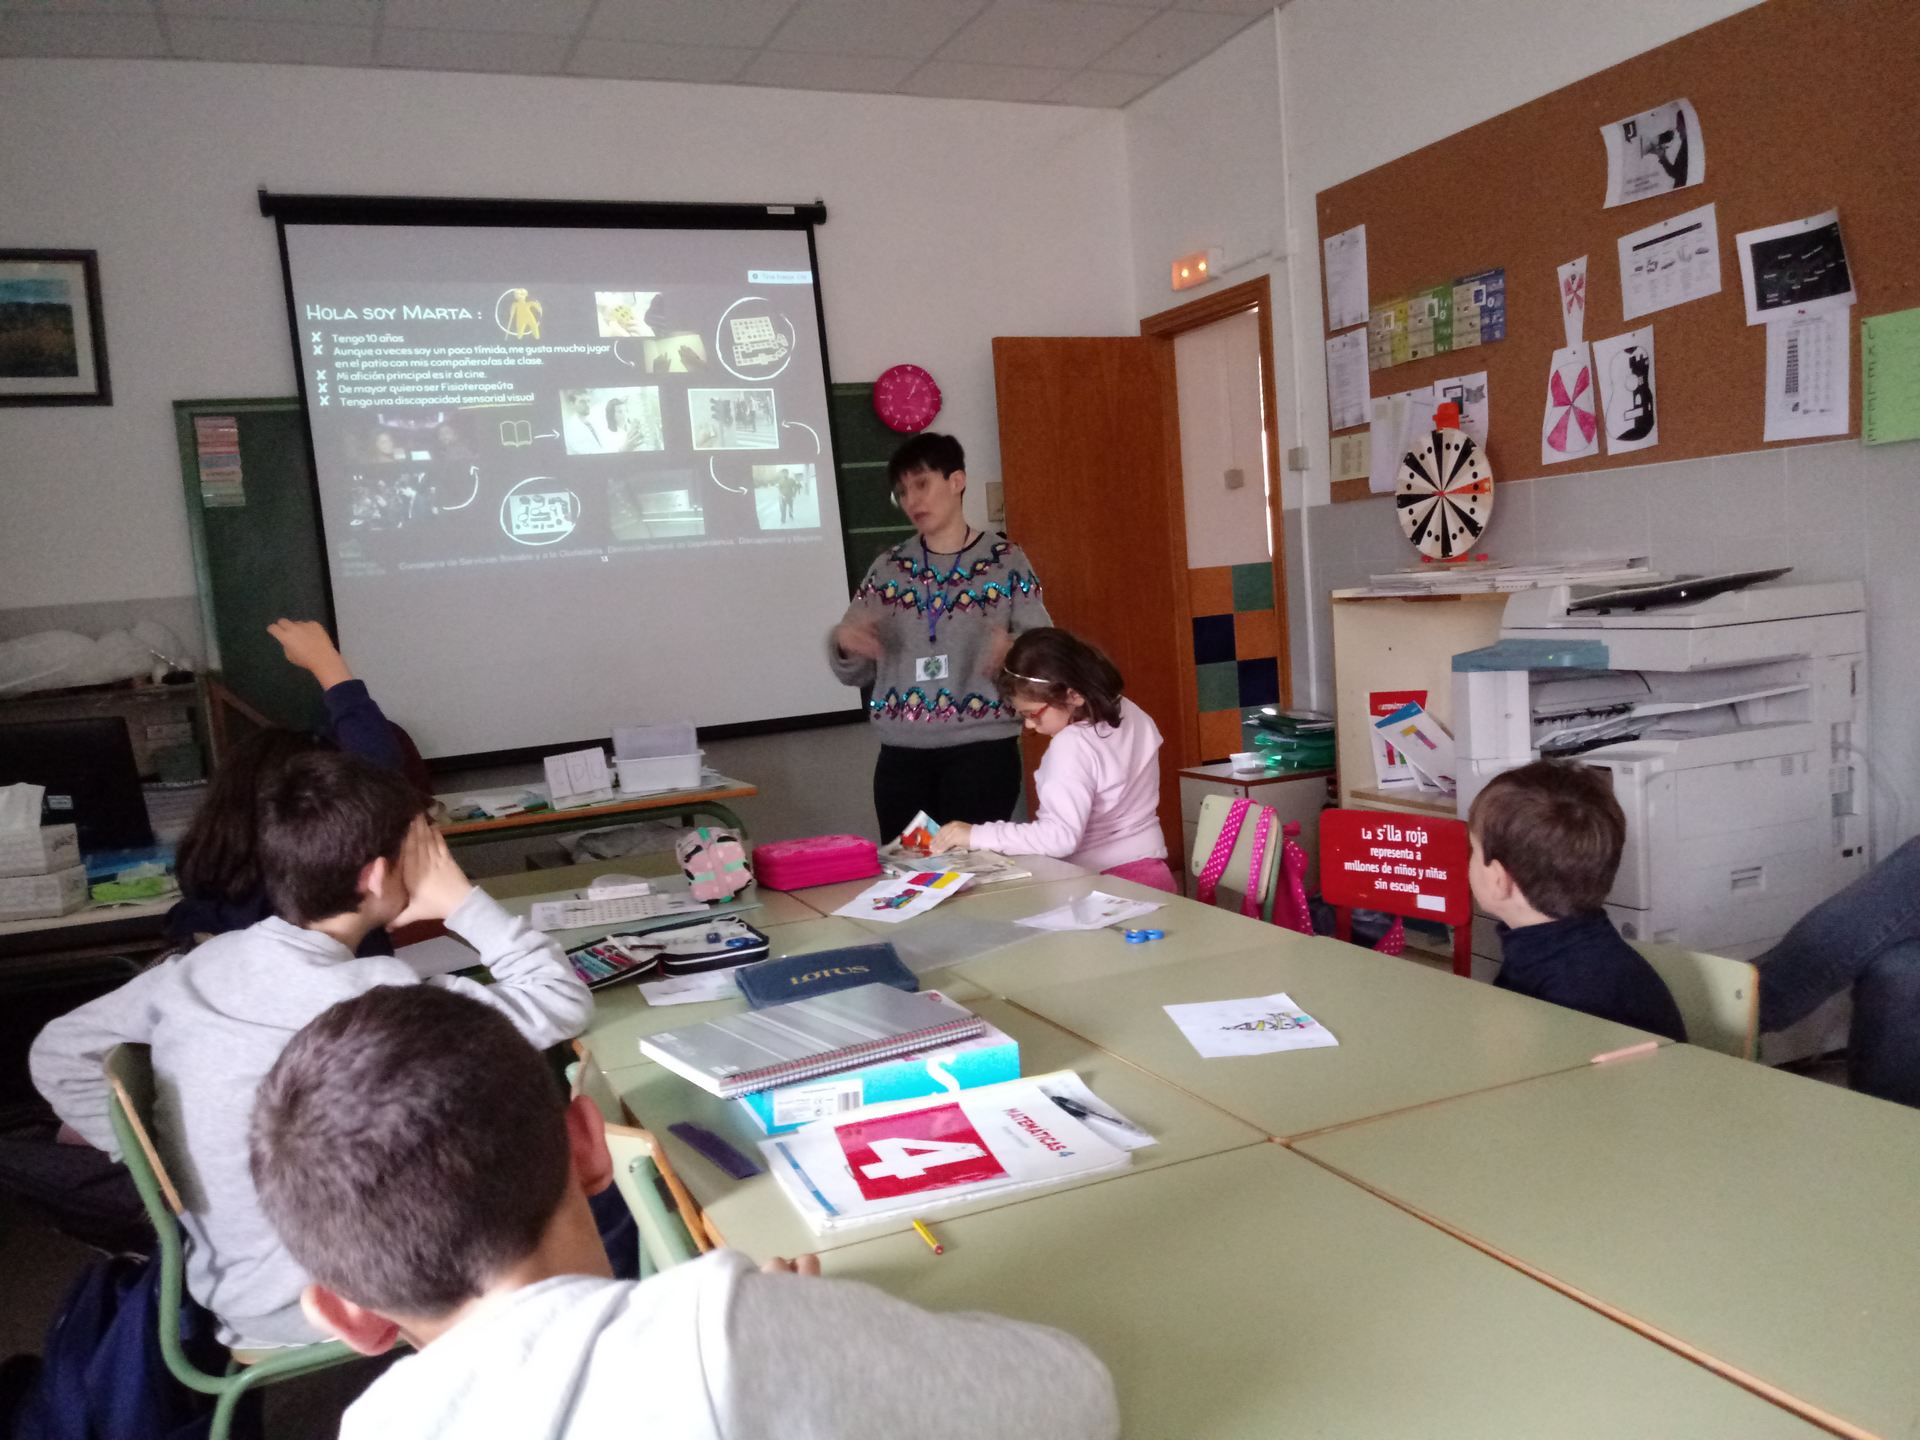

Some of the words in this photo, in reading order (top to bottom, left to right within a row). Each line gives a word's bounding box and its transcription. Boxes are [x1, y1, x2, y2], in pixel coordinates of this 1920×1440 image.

[332, 334, 365, 345] Tengo
[365, 334, 377, 343] 10
[378, 333, 405, 343] años
[333, 347, 374, 357] Aunque
[414, 348, 431, 357] soy
[433, 346, 446, 355] un
[448, 347, 473, 357] poco
[510, 346, 524, 354] me
[525, 345, 552, 356] gusta
[554, 343, 585, 353] mucho
[586, 344, 611, 355] jugar
[335, 360, 349, 368] en
[350, 359, 360, 368] el
[361, 359, 389, 370] patio
[389, 360, 408, 368] con
[410, 358, 429, 367] mis
[430, 356, 504, 369] compañero/as
[505, 356, 516, 365] de
[517, 355, 544, 365] clase.
[336, 371, 349, 381] Mi
[350, 370, 385, 381] afición
[386, 370, 431, 382] principal
[432, 371, 444, 379] es
[445, 370, 453, 379] ir
[454, 369, 463, 379] al
[464, 370, 487, 379] cine.
[338, 384, 352, 394] De
[354, 385, 387, 395] mayor
[389, 383, 423, 394] quiero
[424, 383, 439, 392] ser
[340, 397, 373, 409] Tengo
[374, 398, 395, 406] una
[395, 395, 460, 407] discapacidad
[462, 394, 506, 404] sensorial
[507, 392, 535, 402] visual
[1405, 826, 1428, 848] roja
[1370, 847, 1415, 860] representa
[1415, 851, 1422, 861] a
[1344, 860, 1380, 873] millones
[1381, 862, 1392, 874] de
[1394, 863, 1417, 877] niños
[1418, 868, 1424, 880] y
[1425, 867, 1447, 880] niñas
[1374, 878, 1388, 890] sin
[1389, 881, 1420, 894] escuela
[789, 963, 872, 986] LOTUS
[1002, 1107, 1067, 1152] MATEMÁTICAS
[859, 1137, 988, 1180] 4
